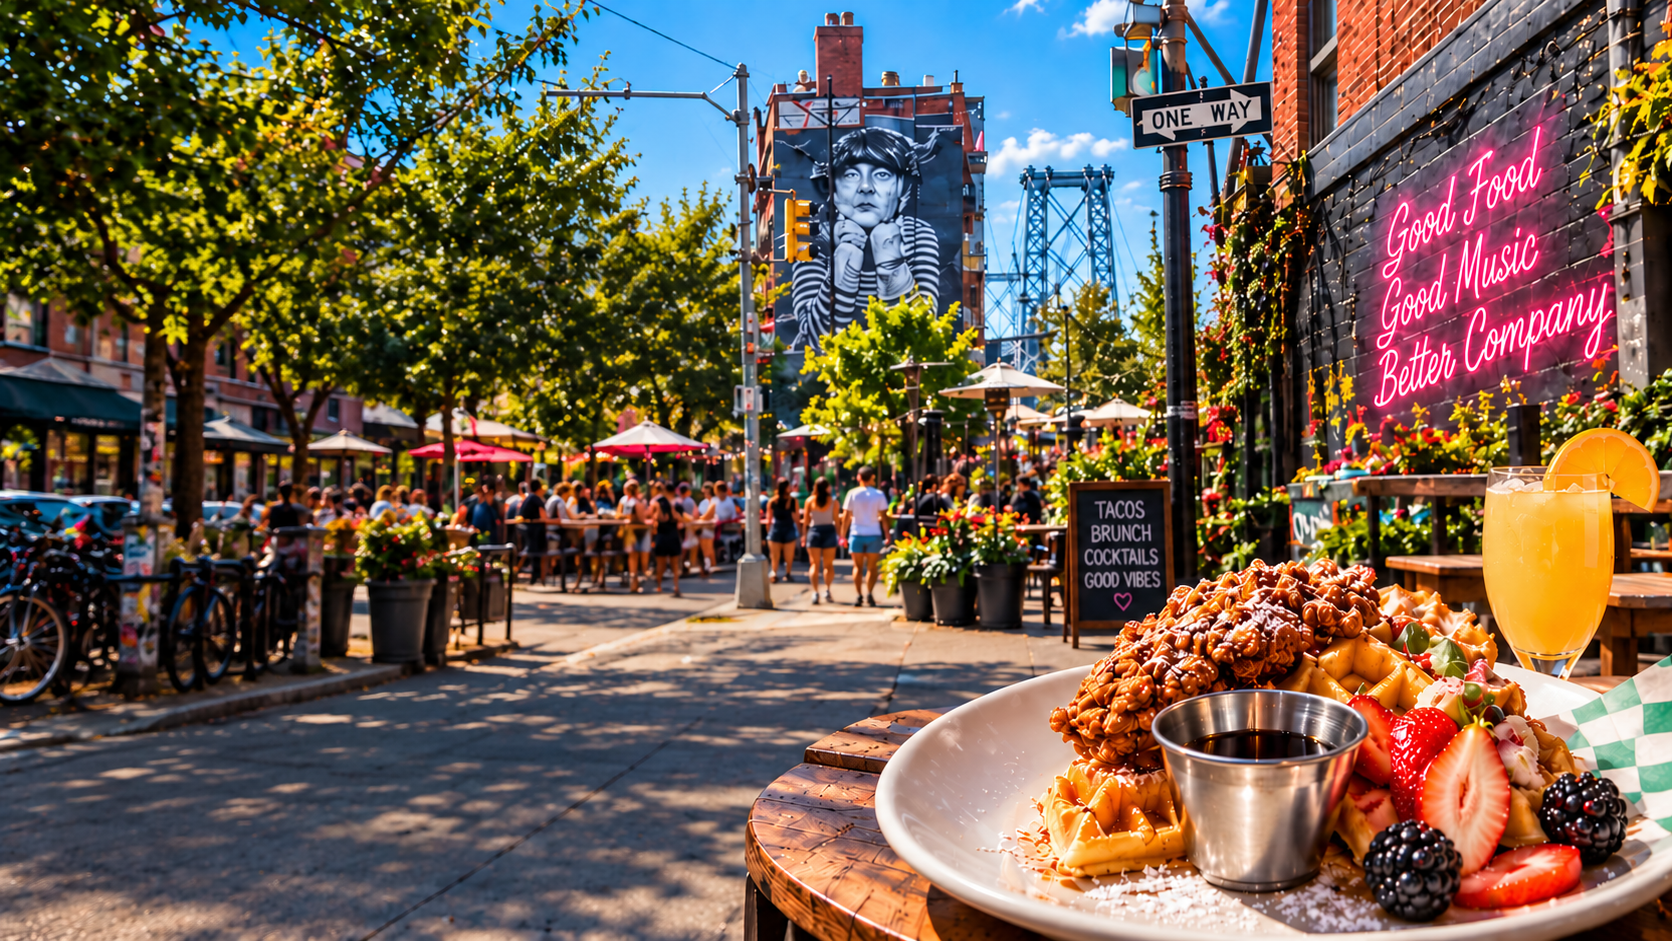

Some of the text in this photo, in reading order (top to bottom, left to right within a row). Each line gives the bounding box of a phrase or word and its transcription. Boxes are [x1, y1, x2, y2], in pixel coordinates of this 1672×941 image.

[1152, 99, 1252, 129] ONE WAY
[1382, 125, 1543, 279] Good Food
[1376, 226, 1539, 350] Good Music
[1373, 283, 1613, 409] Better Company
[1094, 500, 1145, 519] TACOS
[1090, 524, 1152, 543] BRUNCH
[1084, 548, 1159, 566] COCKTAILS
[1084, 571, 1161, 589] GOOD VIBES
